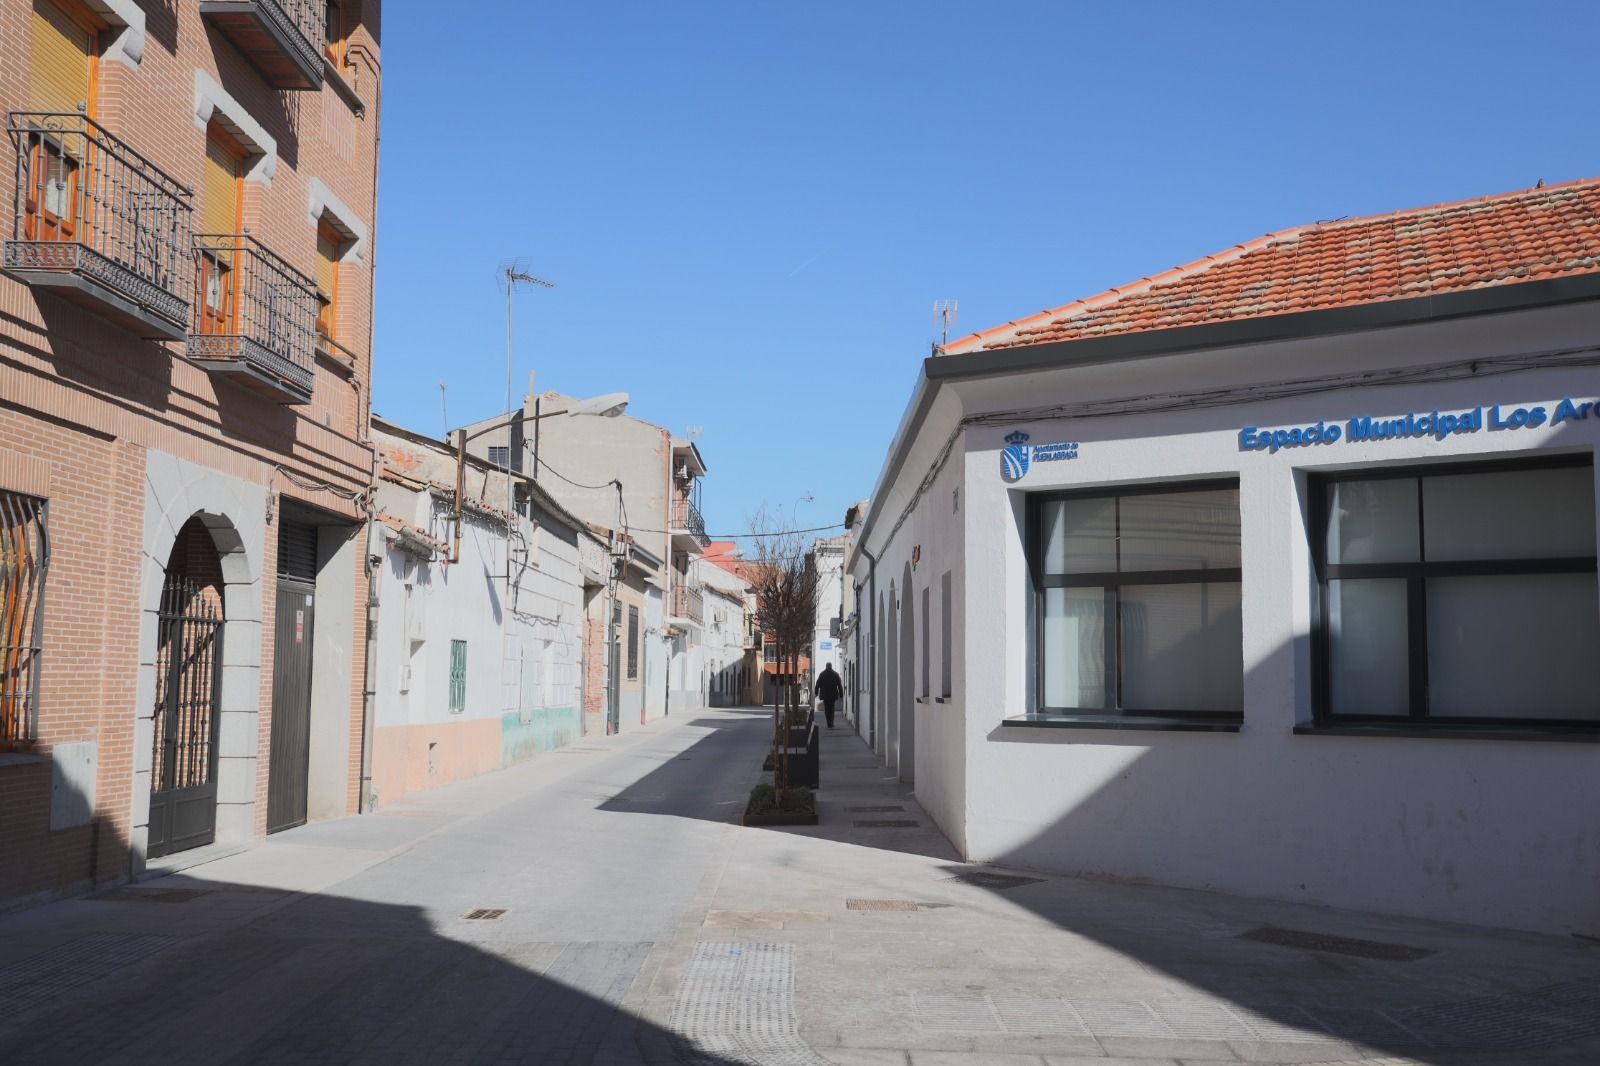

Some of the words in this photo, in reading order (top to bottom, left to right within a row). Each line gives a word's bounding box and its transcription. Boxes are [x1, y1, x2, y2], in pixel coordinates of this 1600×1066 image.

[1239, 420, 1341, 451] Espacio
[1347, 404, 1482, 441] Municipal
[1489, 403, 1547, 429] Los
